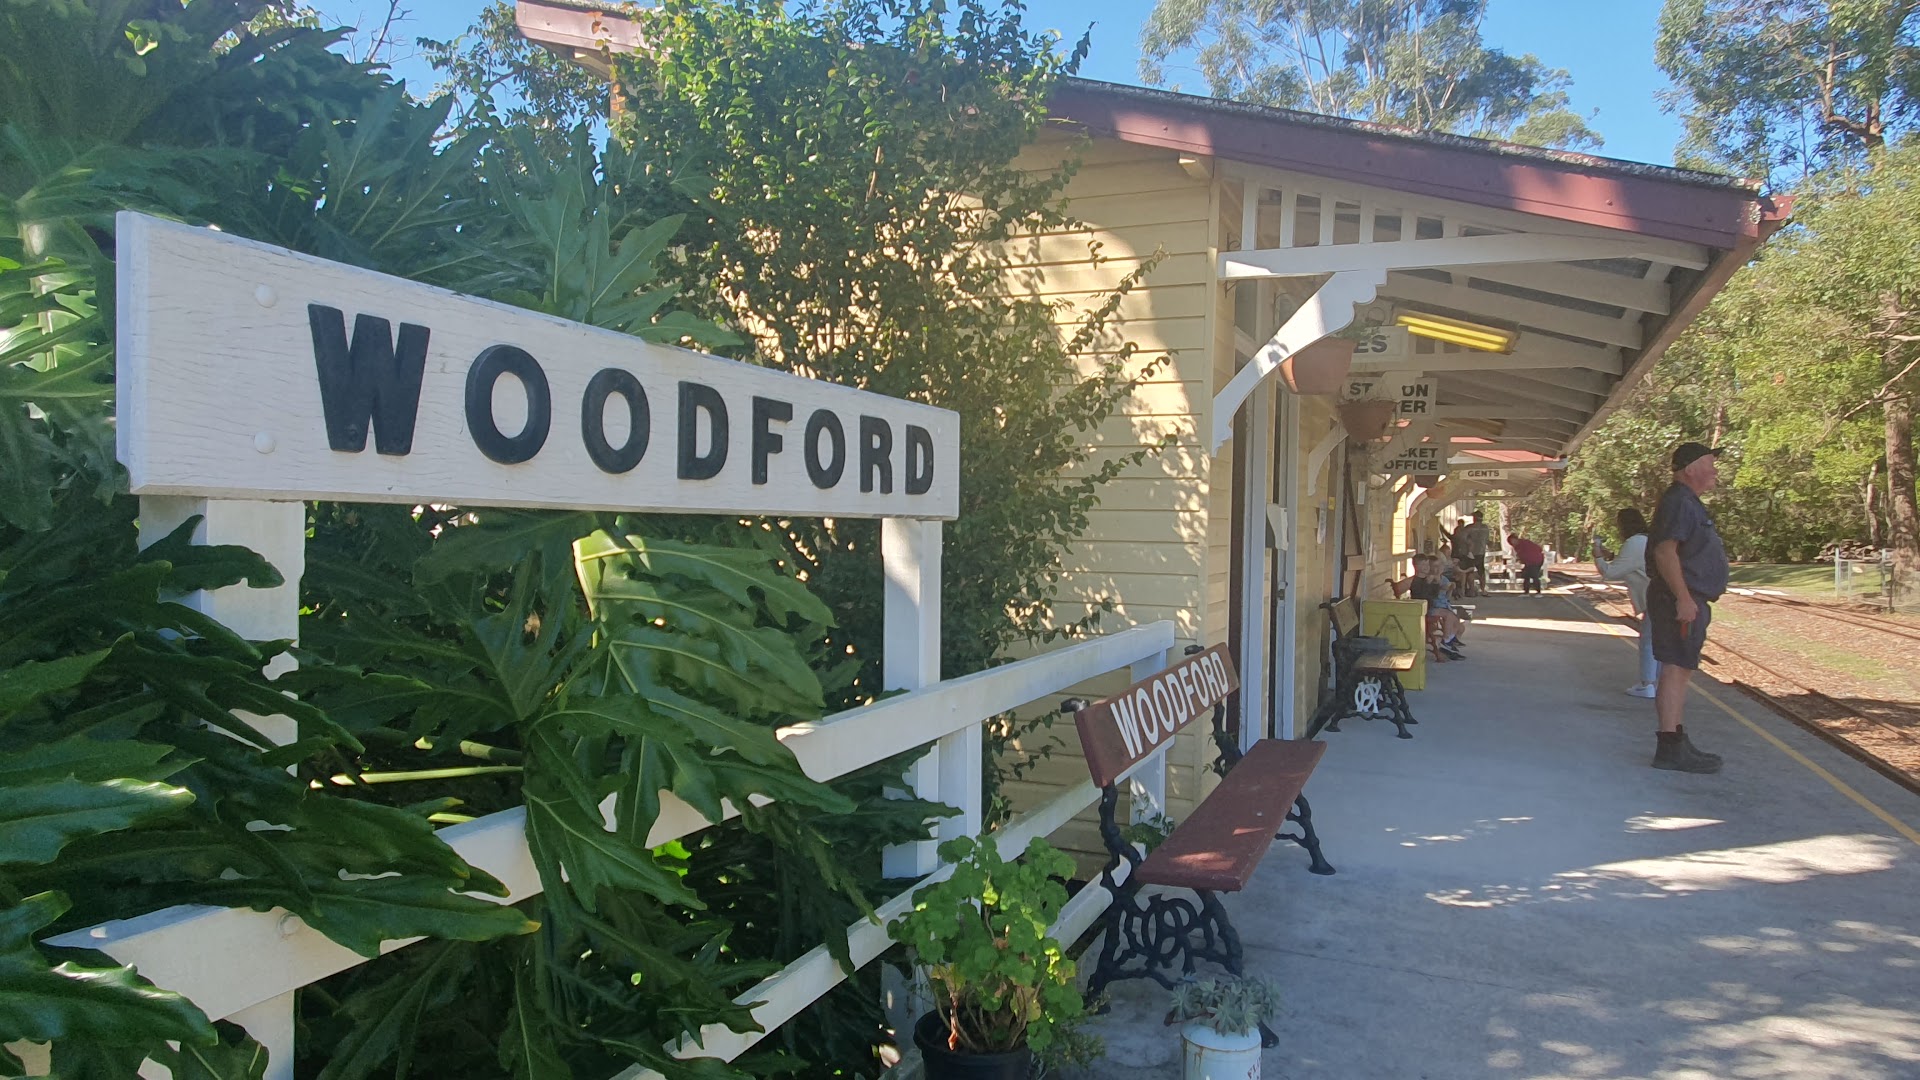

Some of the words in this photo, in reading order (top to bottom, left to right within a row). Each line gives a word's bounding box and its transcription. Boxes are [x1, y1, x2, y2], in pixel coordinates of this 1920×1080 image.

[308, 303, 934, 495] WOODFORD
[1349, 382, 1429, 397] STON
[1384, 459, 1438, 470] OFFICE
[1109, 651, 1229, 759] WOODFORD
